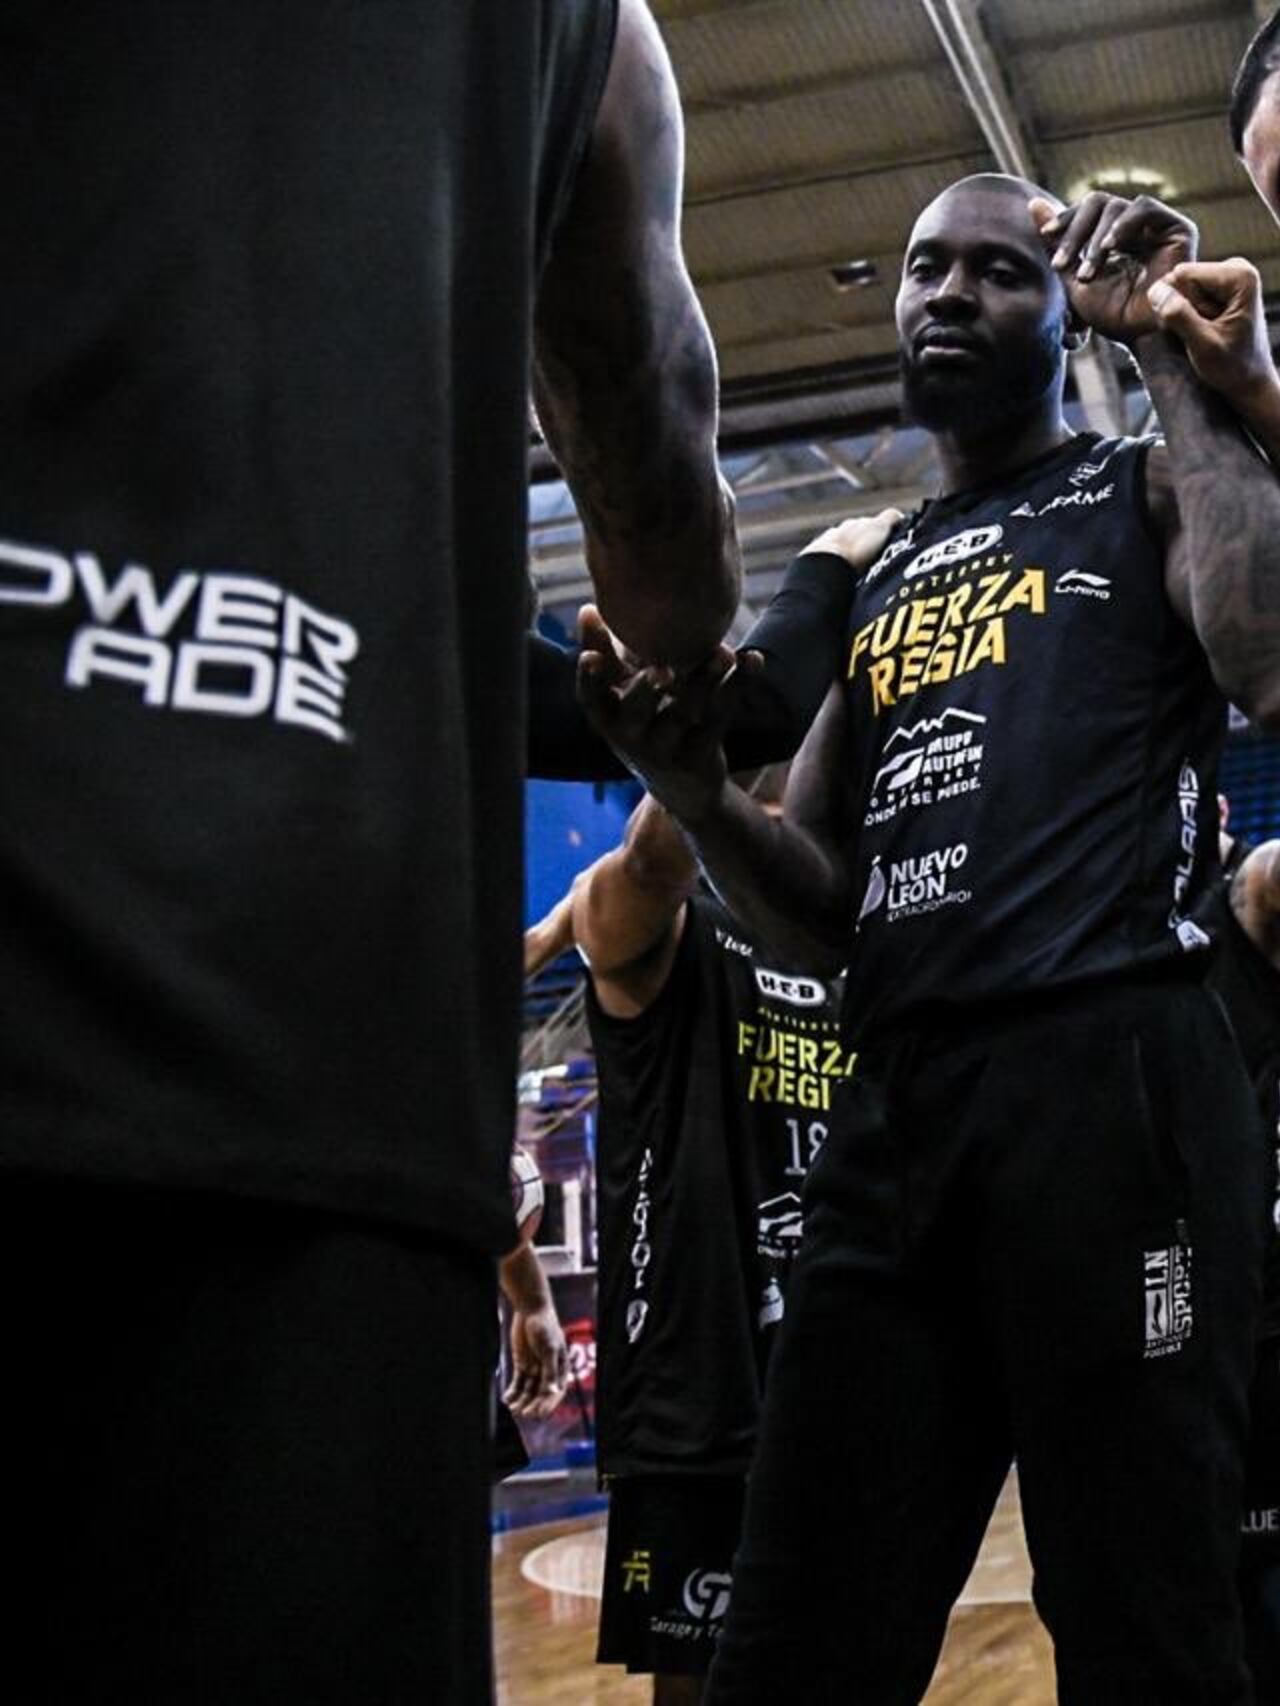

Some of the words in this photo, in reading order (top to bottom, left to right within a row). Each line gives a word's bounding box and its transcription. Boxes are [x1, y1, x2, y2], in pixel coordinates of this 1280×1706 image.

[0, 540, 358, 683] OWER
[847, 568, 1046, 681] FUERZA
[66, 624, 350, 743] ADE
[868, 616, 1007, 717] REGIA
[890, 842, 969, 886] NUEVO
[749, 1065, 831, 1111] REGI
